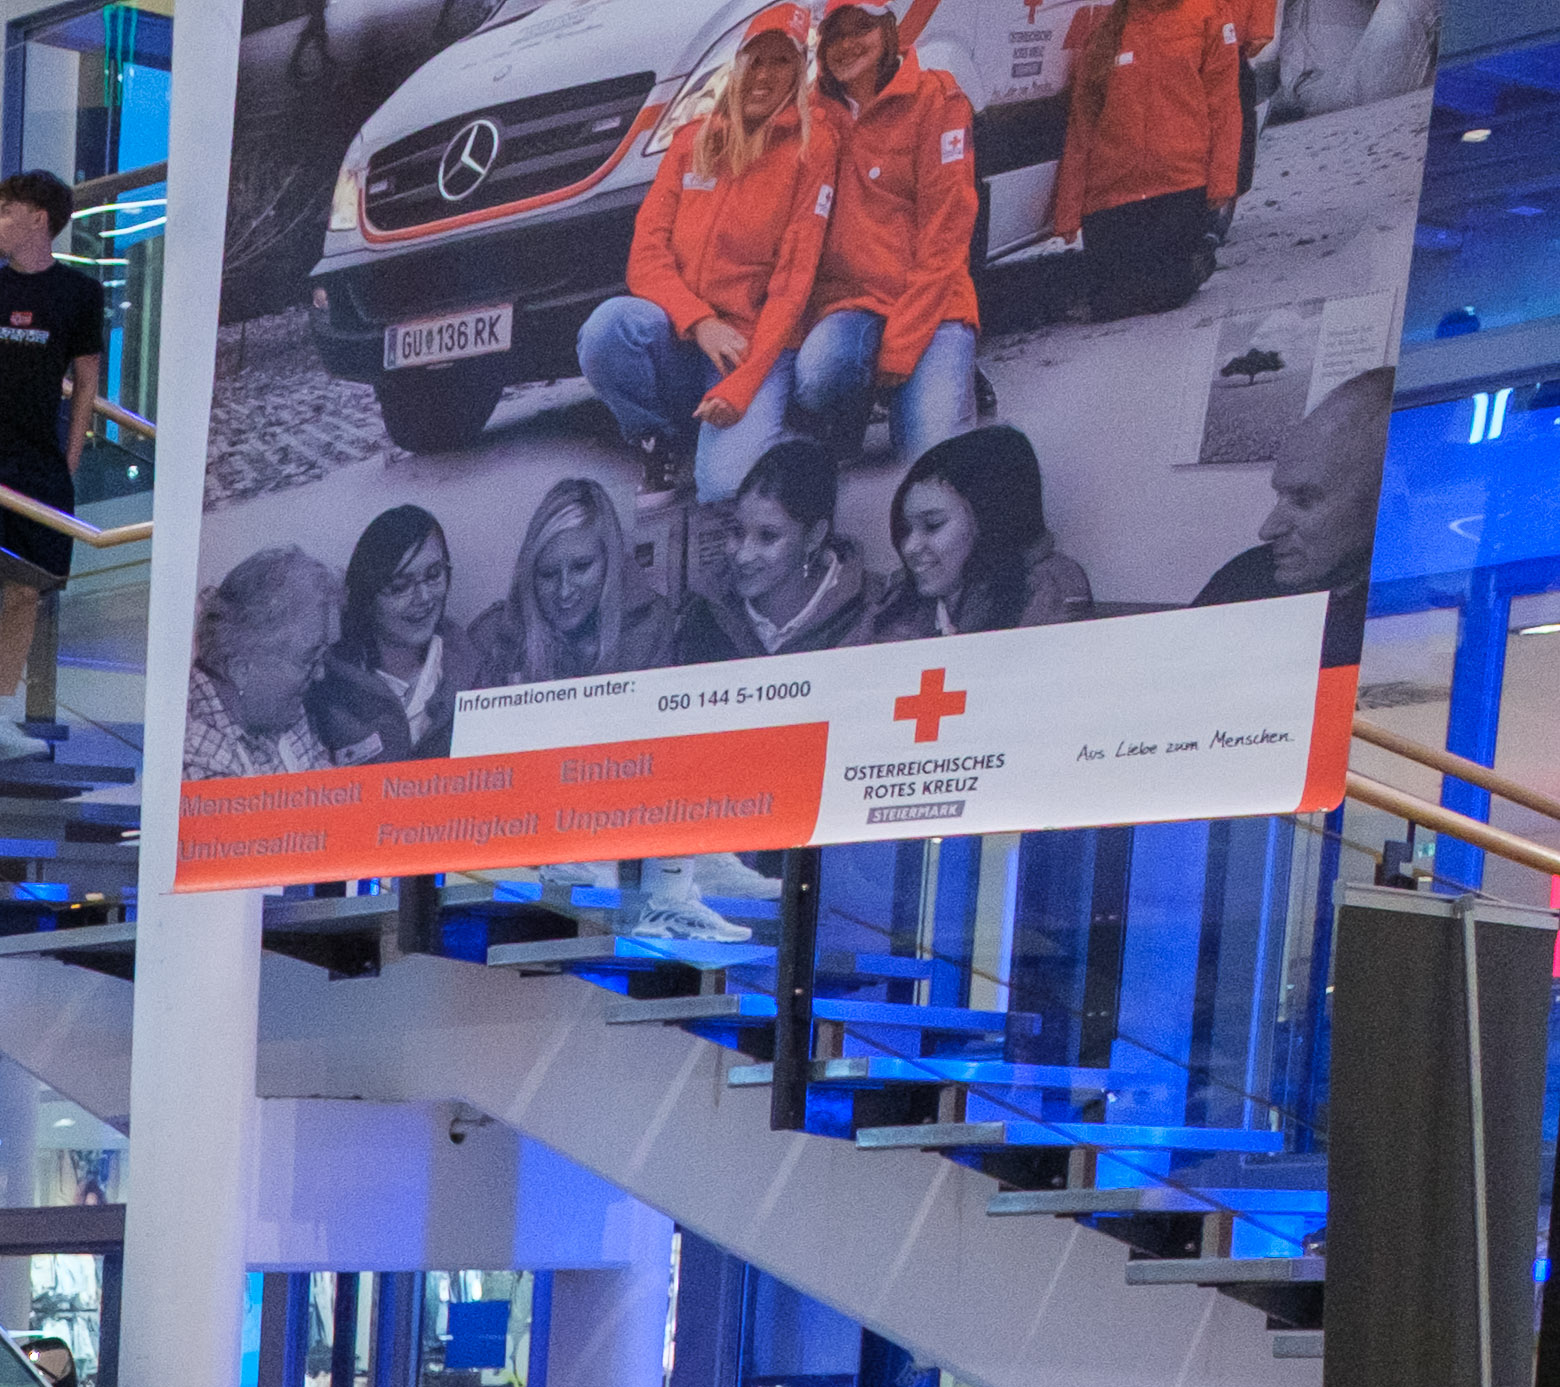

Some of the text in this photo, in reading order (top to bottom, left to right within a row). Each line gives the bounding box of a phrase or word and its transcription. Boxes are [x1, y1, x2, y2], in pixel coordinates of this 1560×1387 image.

[402, 328, 423, 359] GU
[437, 321, 469, 354] 136
[473, 314, 502, 348] RK
[458, 679, 636, 713] Informationen unter:
[657, 680, 812, 713] 050 144 5-10000
[1115, 739, 1159, 759] Liebe
[1165, 739, 1199, 755] zum
[844, 752, 1006, 783] ÖSTERREICHISCHES
[180, 753, 655, 817] Menschlichkeit Neutralität Einheit
[864, 777, 979, 801] ROTES KREUZ
[177, 792, 775, 861] Universalität Freiwilligkeit Unparteilichkeit
[871, 802, 959, 824] STEIERMARK
